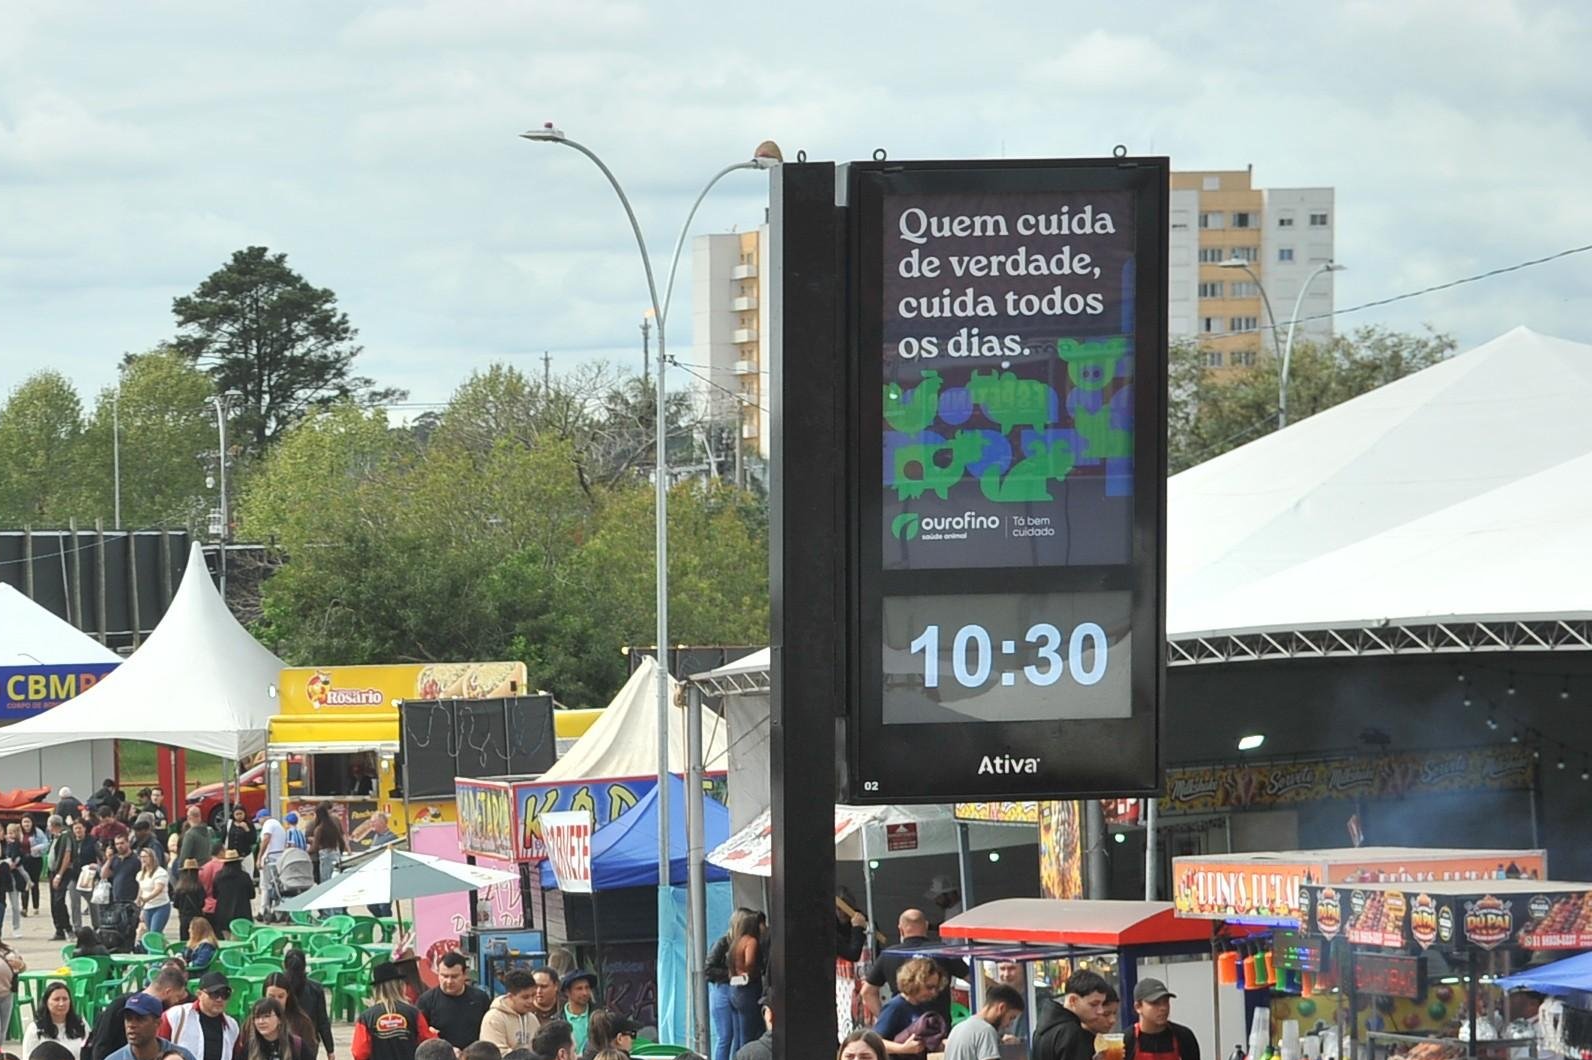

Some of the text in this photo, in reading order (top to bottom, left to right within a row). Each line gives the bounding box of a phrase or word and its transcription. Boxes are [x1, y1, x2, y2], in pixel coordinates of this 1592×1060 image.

[899, 204, 1116, 244] Quem cuida
[898, 246, 1101, 279] de verdade,
[898, 286, 1104, 318] cuida todos
[898, 328, 1031, 359] os dias.
[921, 511, 1000, 531] ourofino
[1027, 516, 1050, 526] bem
[944, 532, 967, 540] animal
[1012, 527, 1055, 537] cuidado
[909, 621, 1109, 688] 10:30
[977, 755, 1040, 774] Ativa
[864, 780, 879, 791] 02
